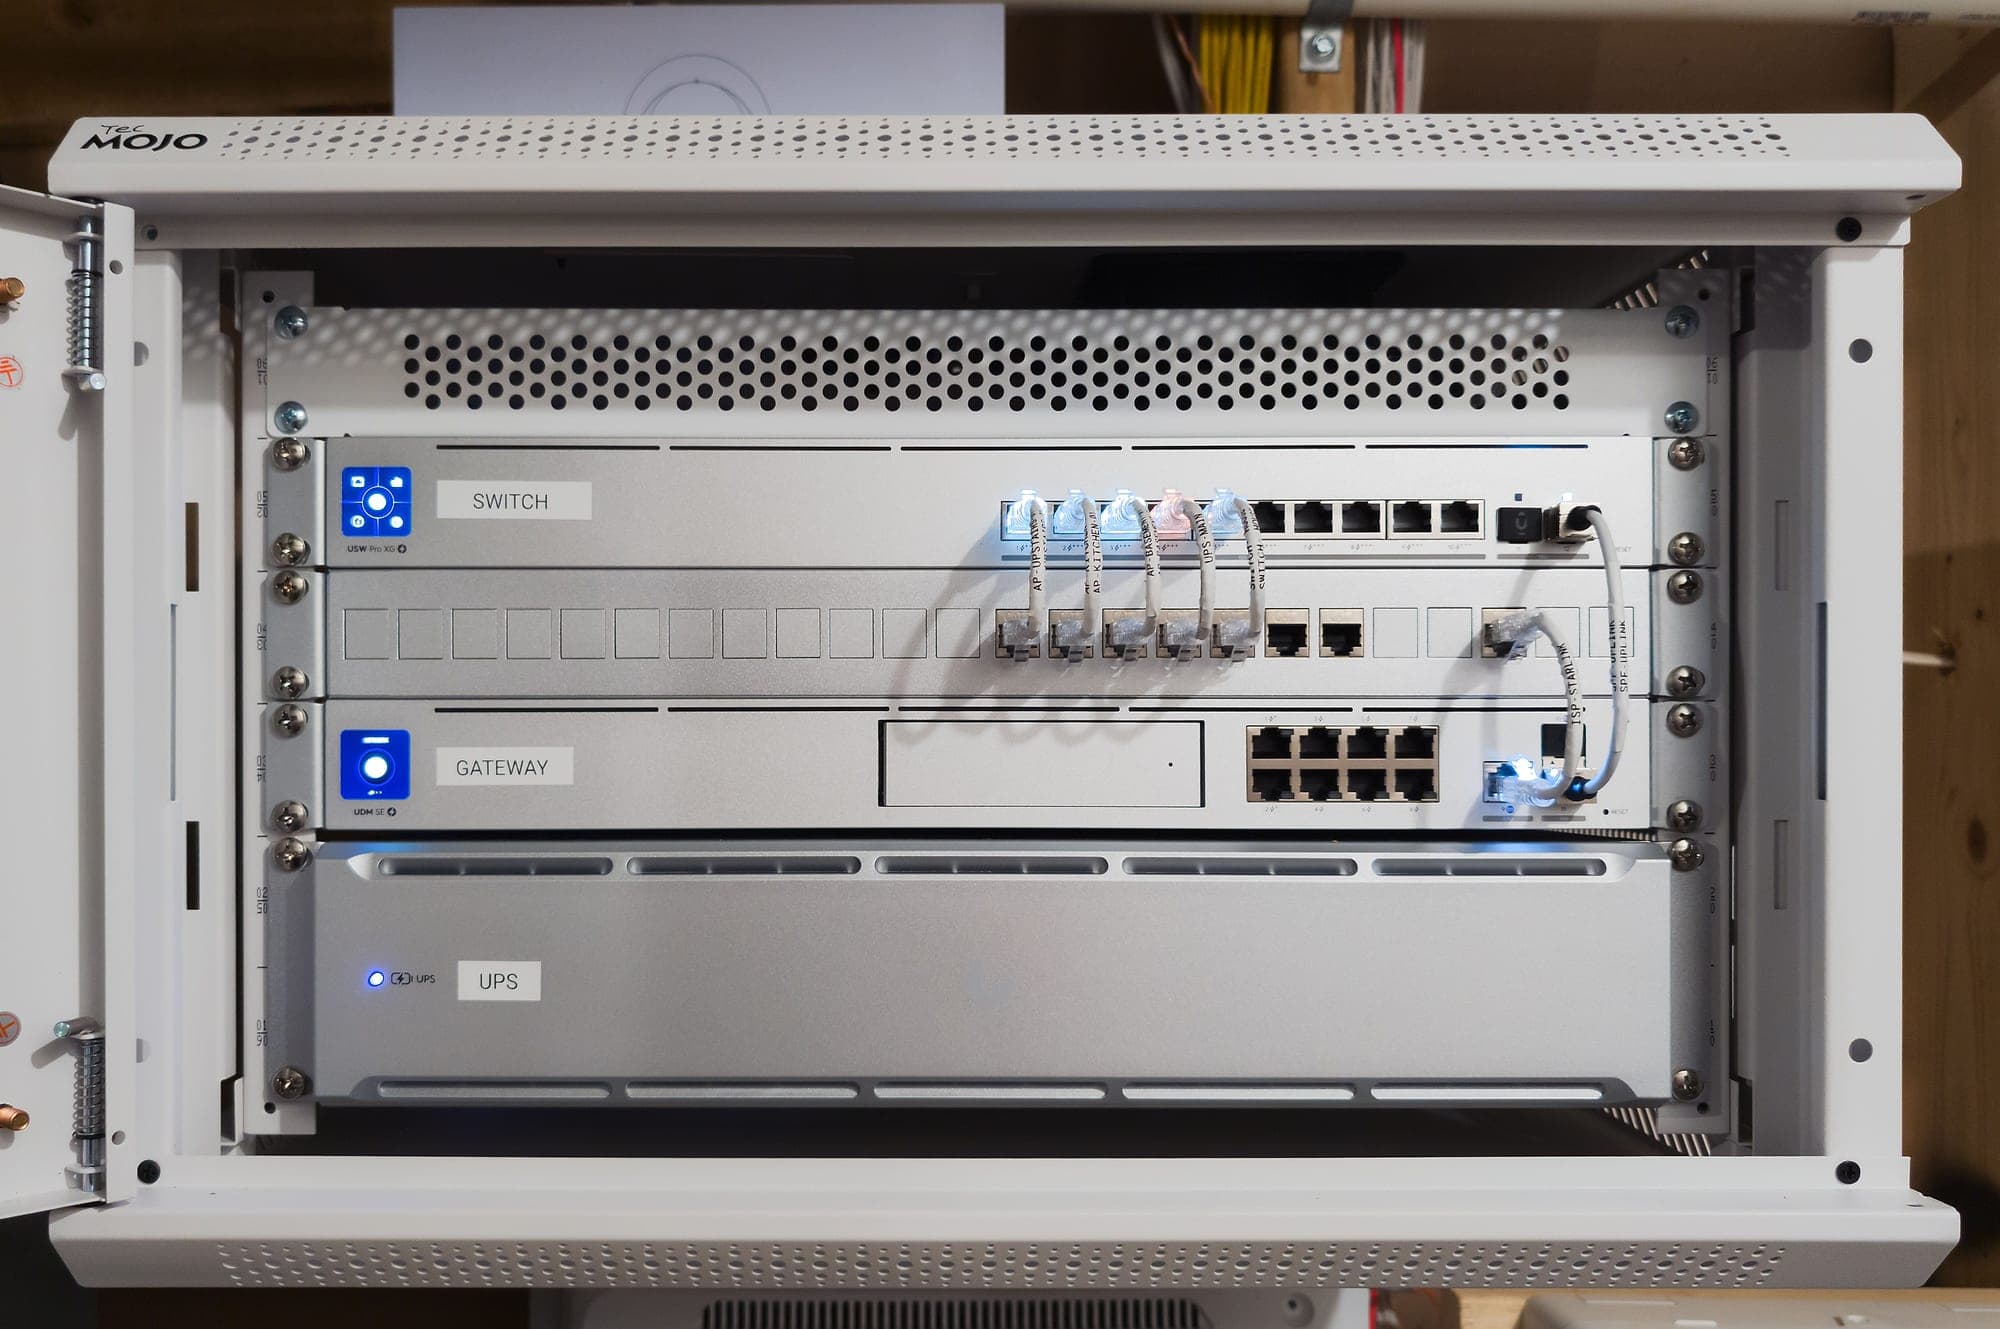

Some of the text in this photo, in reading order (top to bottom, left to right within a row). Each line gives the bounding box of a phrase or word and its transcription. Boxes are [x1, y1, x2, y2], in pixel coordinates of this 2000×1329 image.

[101, 124, 145, 135] Tec
[80, 134, 208, 152] MOJO
[473, 493, 549, 510] SWITCH
[1194, 513, 1214, 564] UPS-MAIN
[347, 545, 396, 553] USW Pro XG
[456, 760, 549, 776] GATEWAY
[353, 808, 385, 816] UDM SE
[416, 974, 436, 984] UPS
[479, 973, 518, 990] UPS
